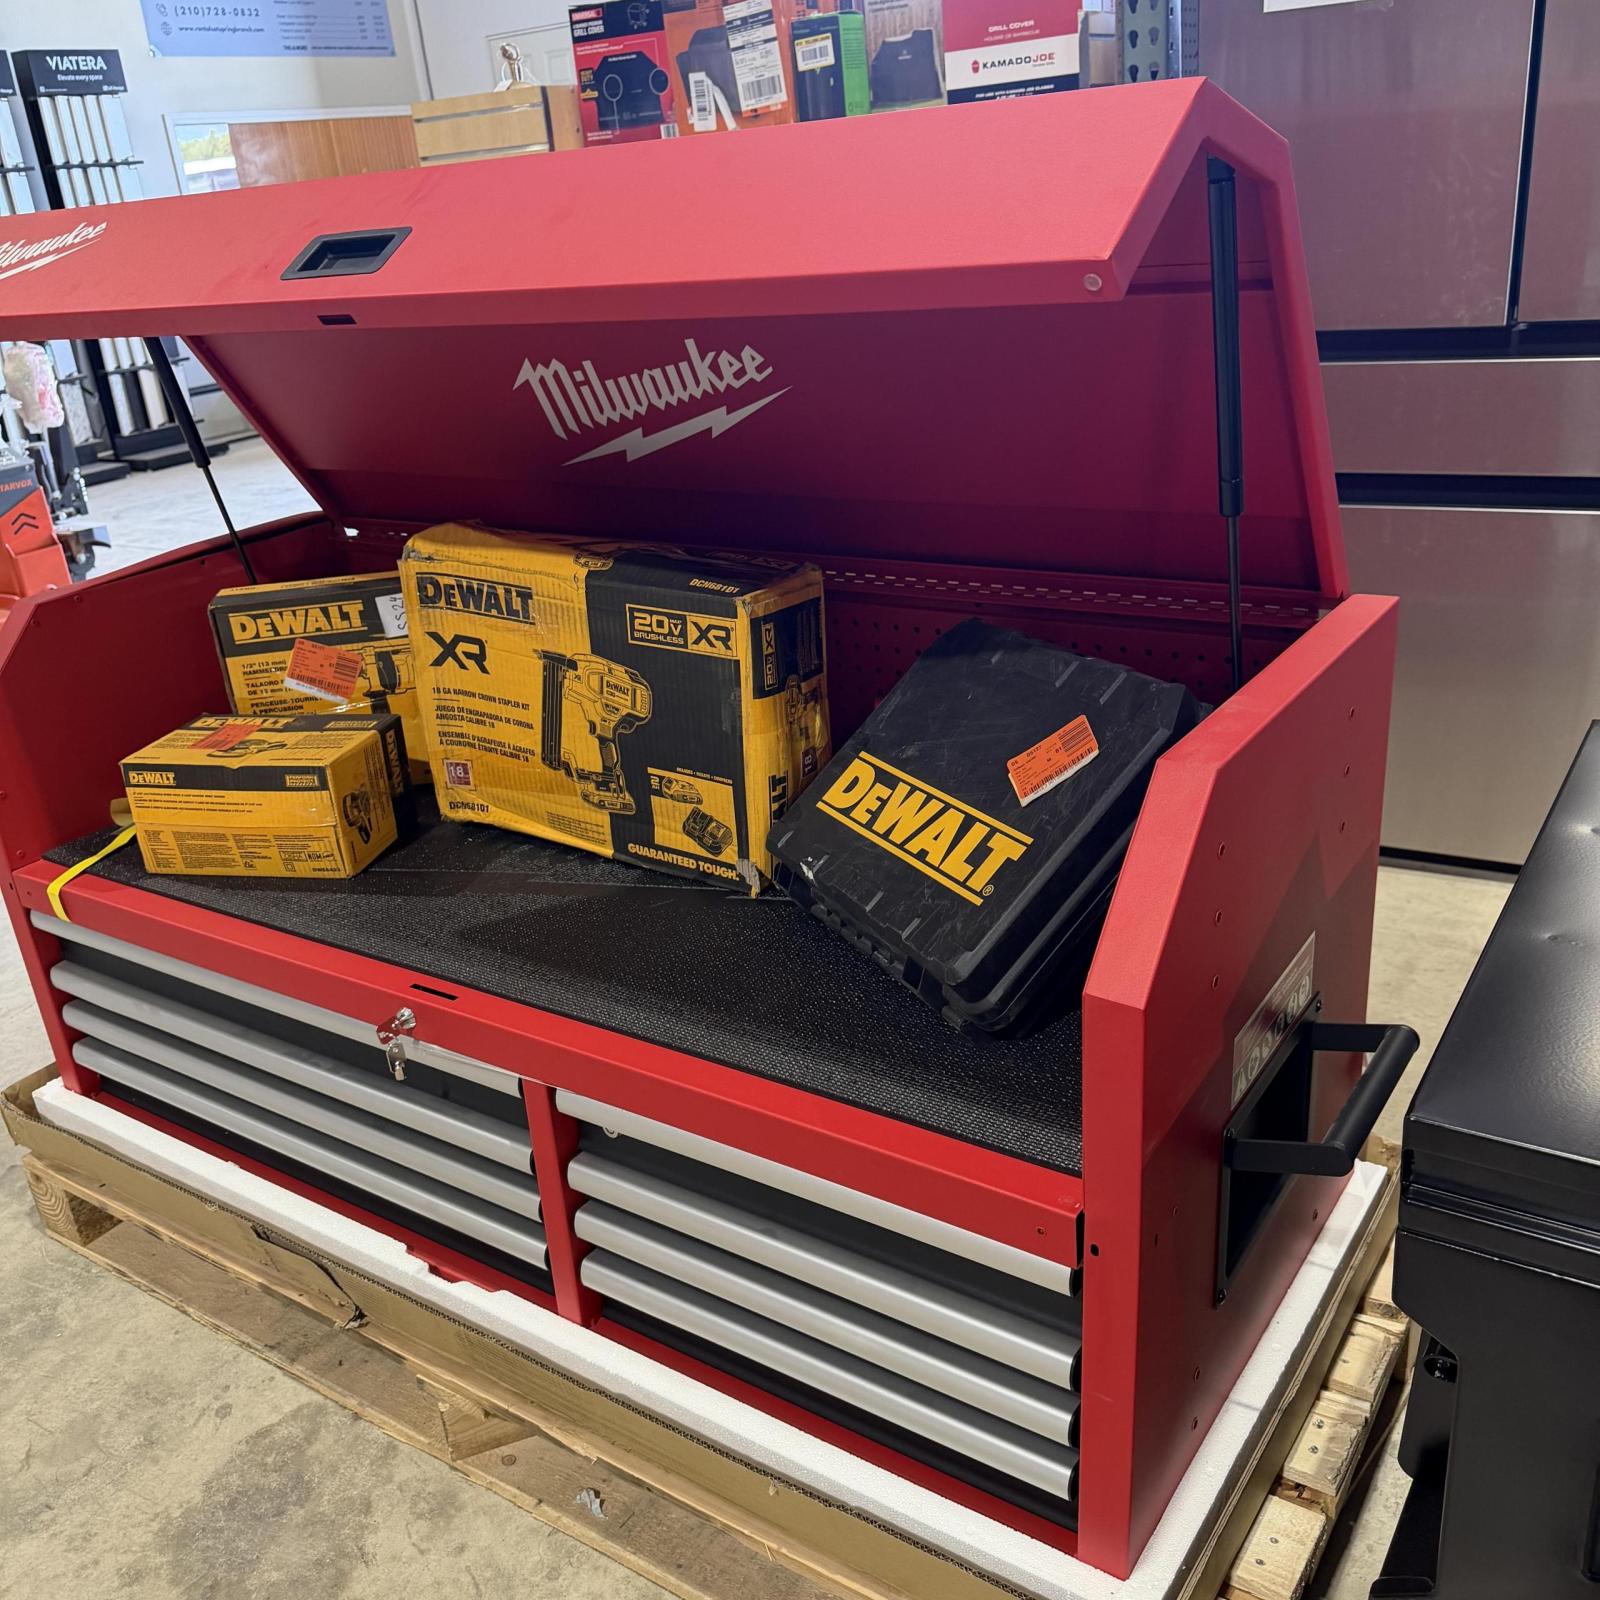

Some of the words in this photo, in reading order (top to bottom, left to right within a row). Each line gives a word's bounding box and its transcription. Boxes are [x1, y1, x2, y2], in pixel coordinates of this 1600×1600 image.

[988, 24, 1009, 33] GRILL
[1009, 19, 1035, 29] COVER
[46, 55, 108, 71] VIATERA
[512, 338, 774, 441] Milwaukee
[417, 574, 534, 621] DEWALT
[228, 602, 366, 645] DEWALT
[633, 631, 685, 646] BRUSHLESS
[690, 620, 734, 652] XR
[424, 631, 491, 675] XR
[453, 688, 477, 699] NARROW
[477, 692, 497, 704] CROWN
[497, 697, 521, 710] STAPLER
[521, 702, 530, 711] KIT
[434, 704, 456, 713] JUEGO
[512, 718, 535, 730] CORONA
[435, 712, 466, 722] ANGOSTA
[465, 715, 487, 727] CALIBRE
[438, 730, 471, 740] ENSEMBLE
[499, 749, 522, 762] CALIBRE
[130, 772, 175, 785] DEWALT
[449, 766, 465, 778] 18
[821, 757, 1028, 893] DEWALT
[627, 842, 698, 870] GUARANTEED
[698, 860, 741, 882] TOUGH.
